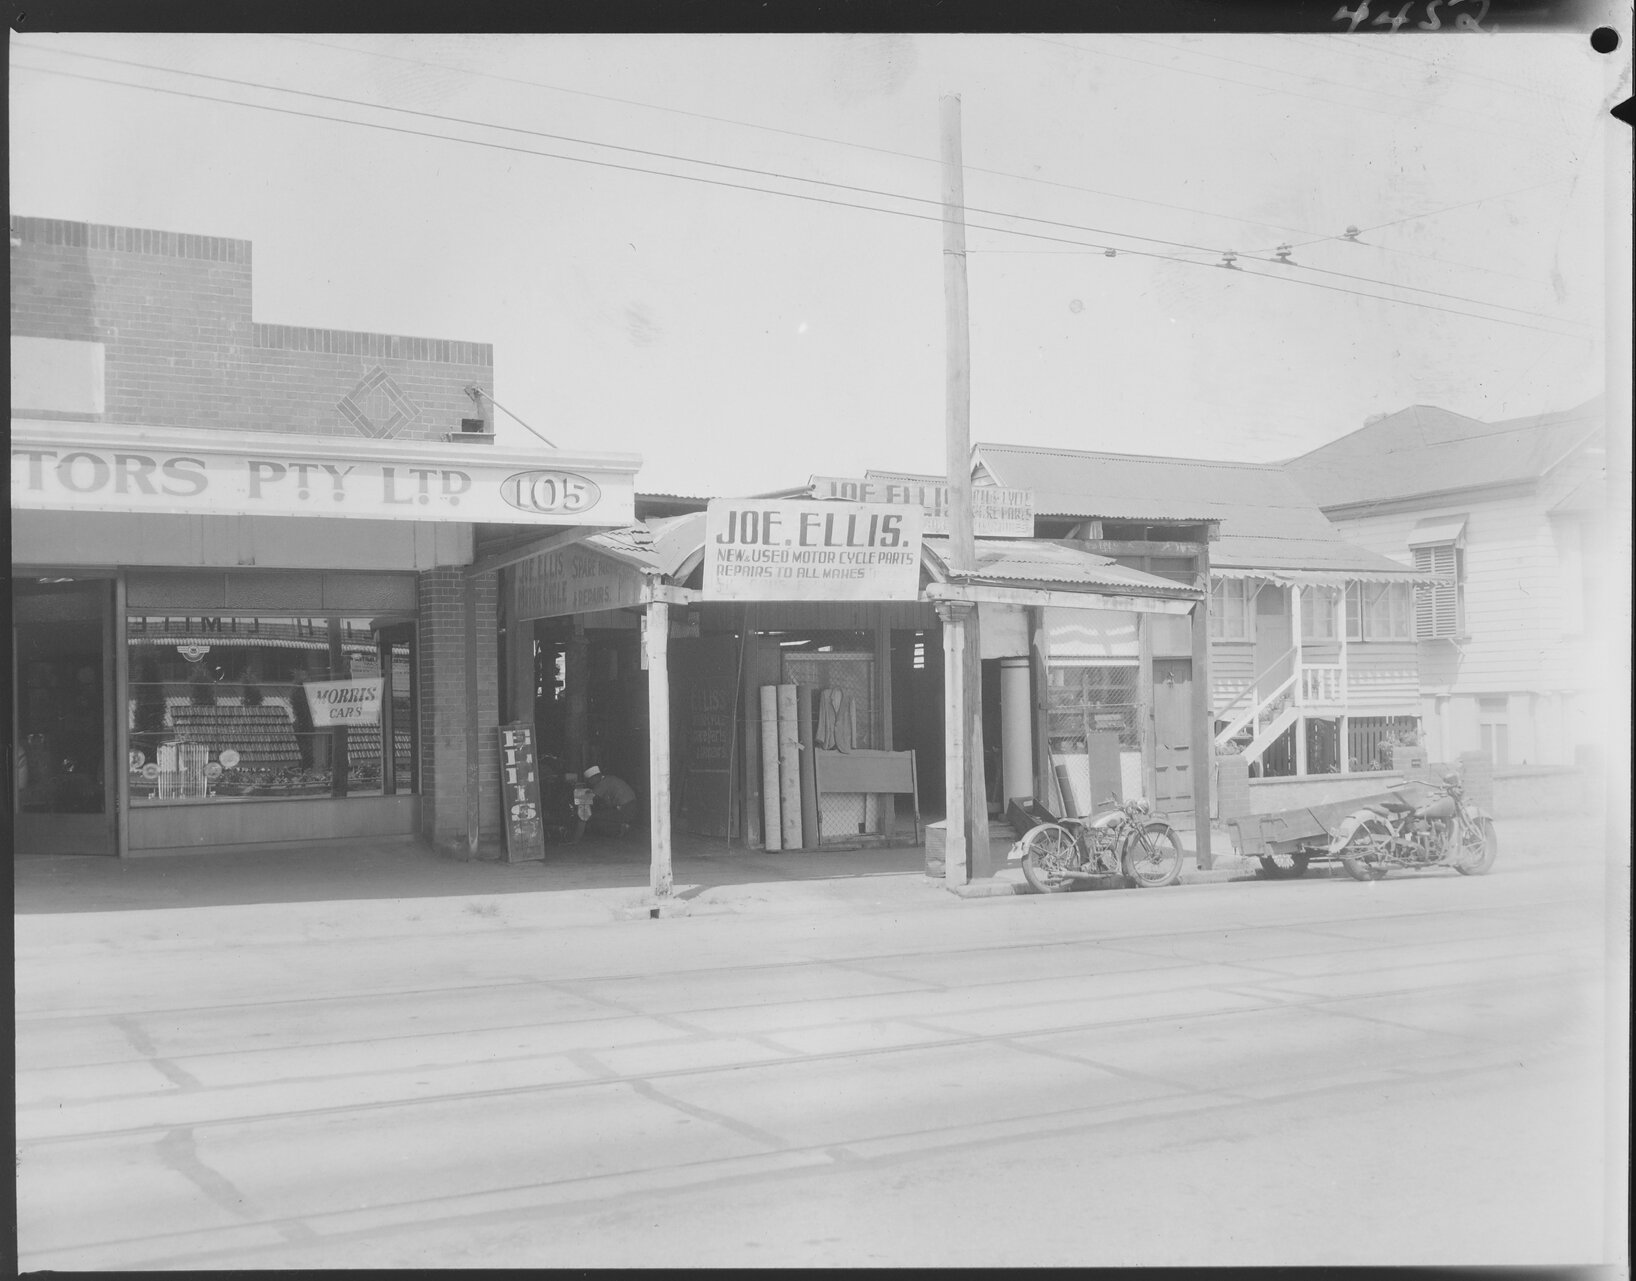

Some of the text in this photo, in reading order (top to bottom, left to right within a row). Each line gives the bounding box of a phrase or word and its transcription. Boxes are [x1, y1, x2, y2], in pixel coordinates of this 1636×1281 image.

[12, 449, 209, 497] TORS
[515, 477, 588, 511] 105
[715, 510, 909, 548] JOE. ELLIS.
[792, 550, 835, 564] MOTOR
[839, 551, 876, 565] CYCLE
[878, 552, 914, 566] PARTS
[716, 564, 772, 578] REPAIRS
[776, 566, 792, 578] TO
[796, 567, 820, 579] ALL
[317, 686, 377, 704] MORRIS
[329, 706, 363, 719] CARS
